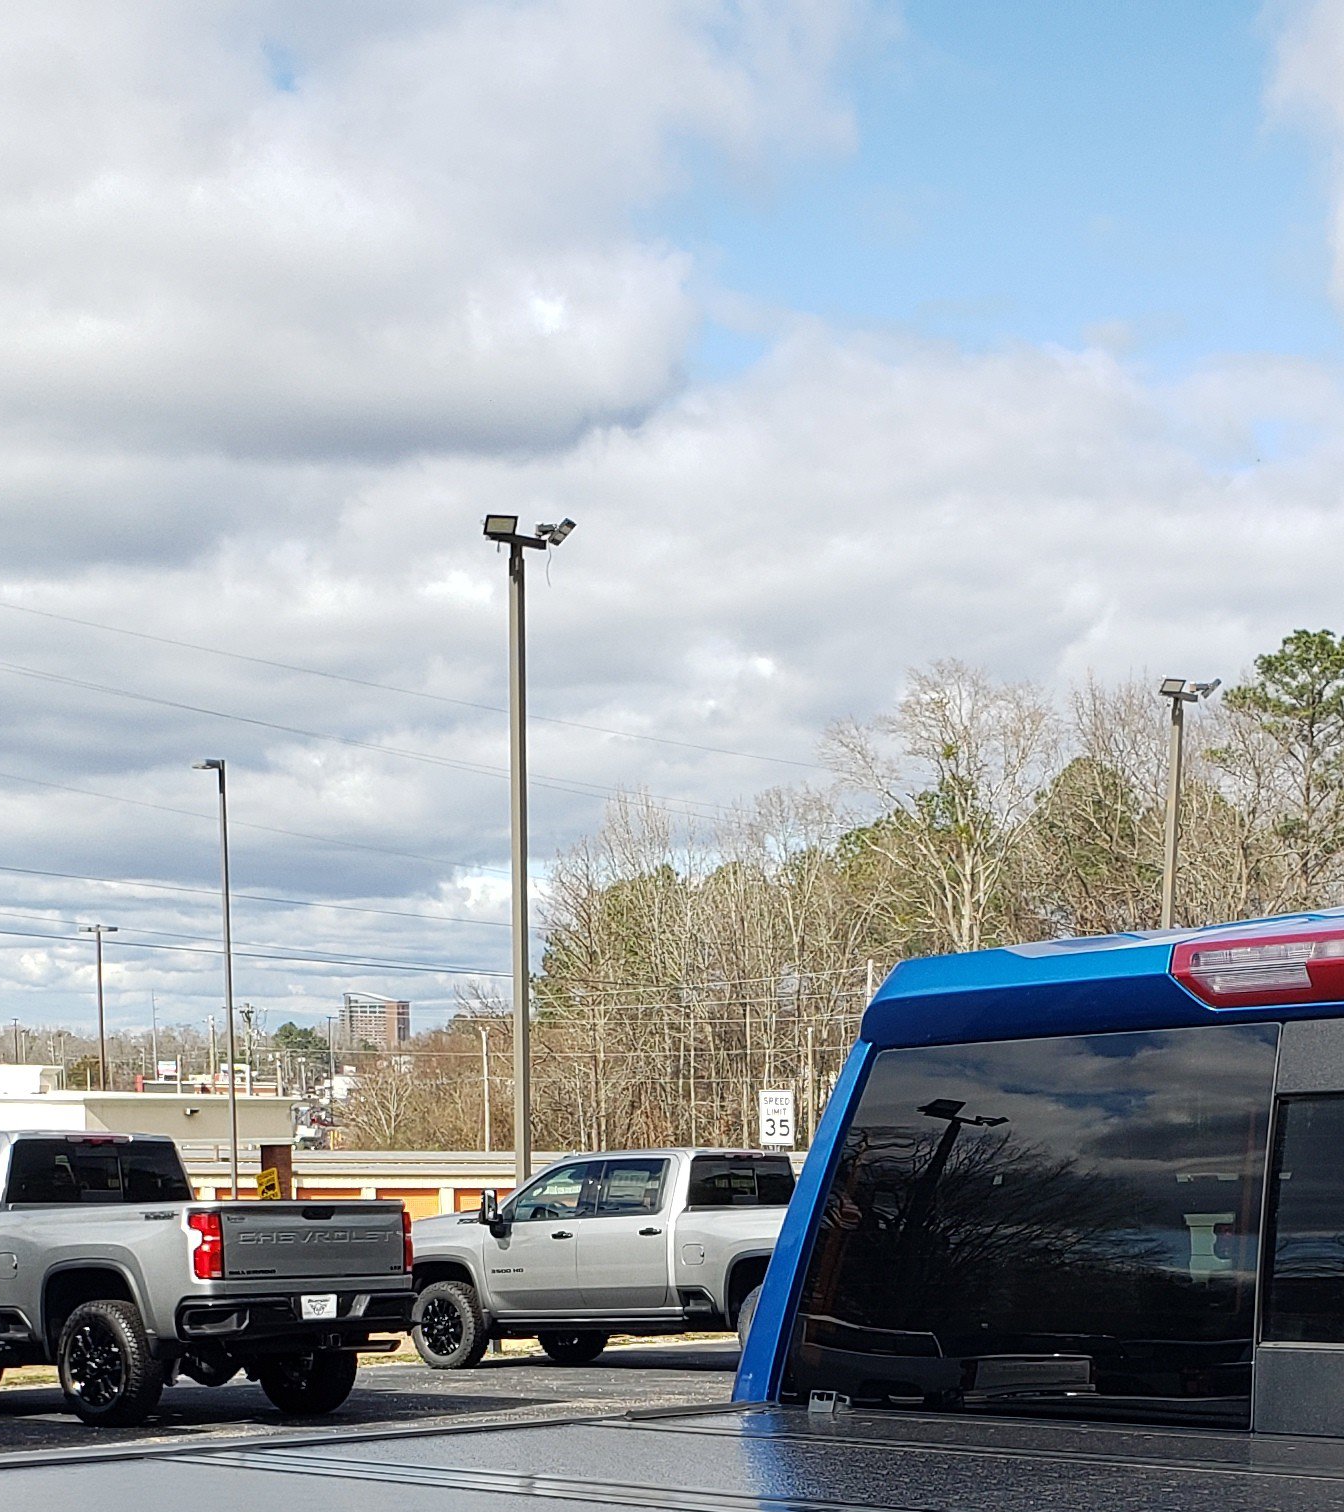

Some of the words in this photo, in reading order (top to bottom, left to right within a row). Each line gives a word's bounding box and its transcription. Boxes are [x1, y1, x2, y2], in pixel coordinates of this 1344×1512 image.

[763, 1096, 790, 1105] SPEED
[765, 1118, 790, 1136] 35
[238, 1229, 394, 1245] CHEVROLET
